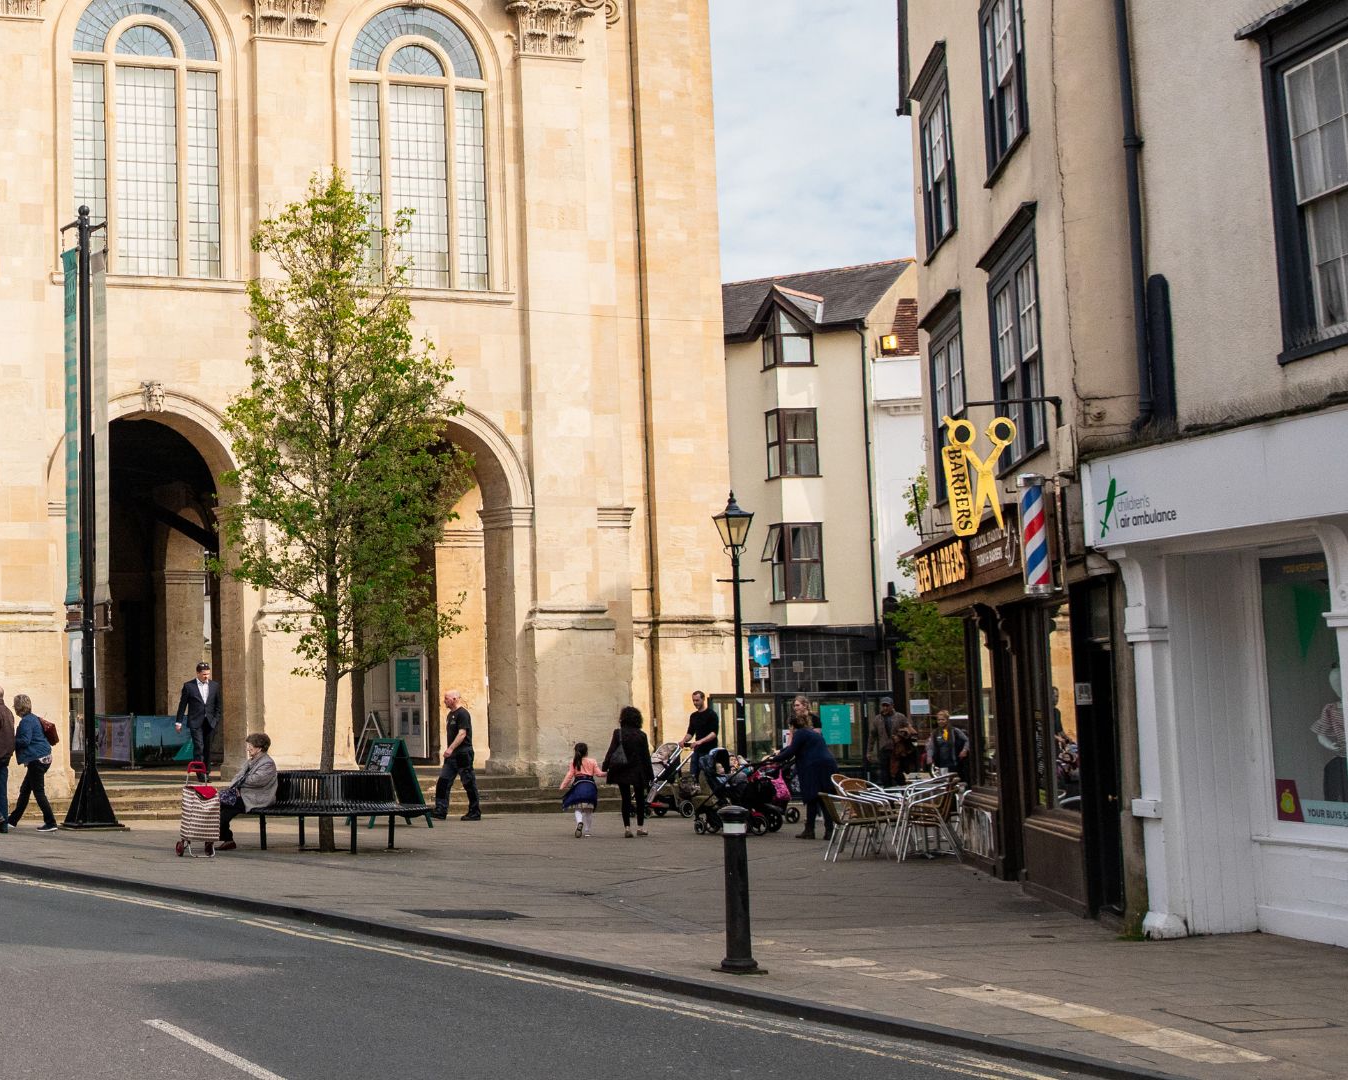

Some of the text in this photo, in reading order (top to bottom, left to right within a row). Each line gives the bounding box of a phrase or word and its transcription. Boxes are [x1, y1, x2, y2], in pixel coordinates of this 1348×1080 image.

[948, 448, 973, 531] BARBERS
[1117, 495, 1150, 512] children's
[1120, 509, 1177, 528] air ambulance
[1307, 808, 1325, 818] YOUR
[1326, 809, 1342, 819] BUYS
